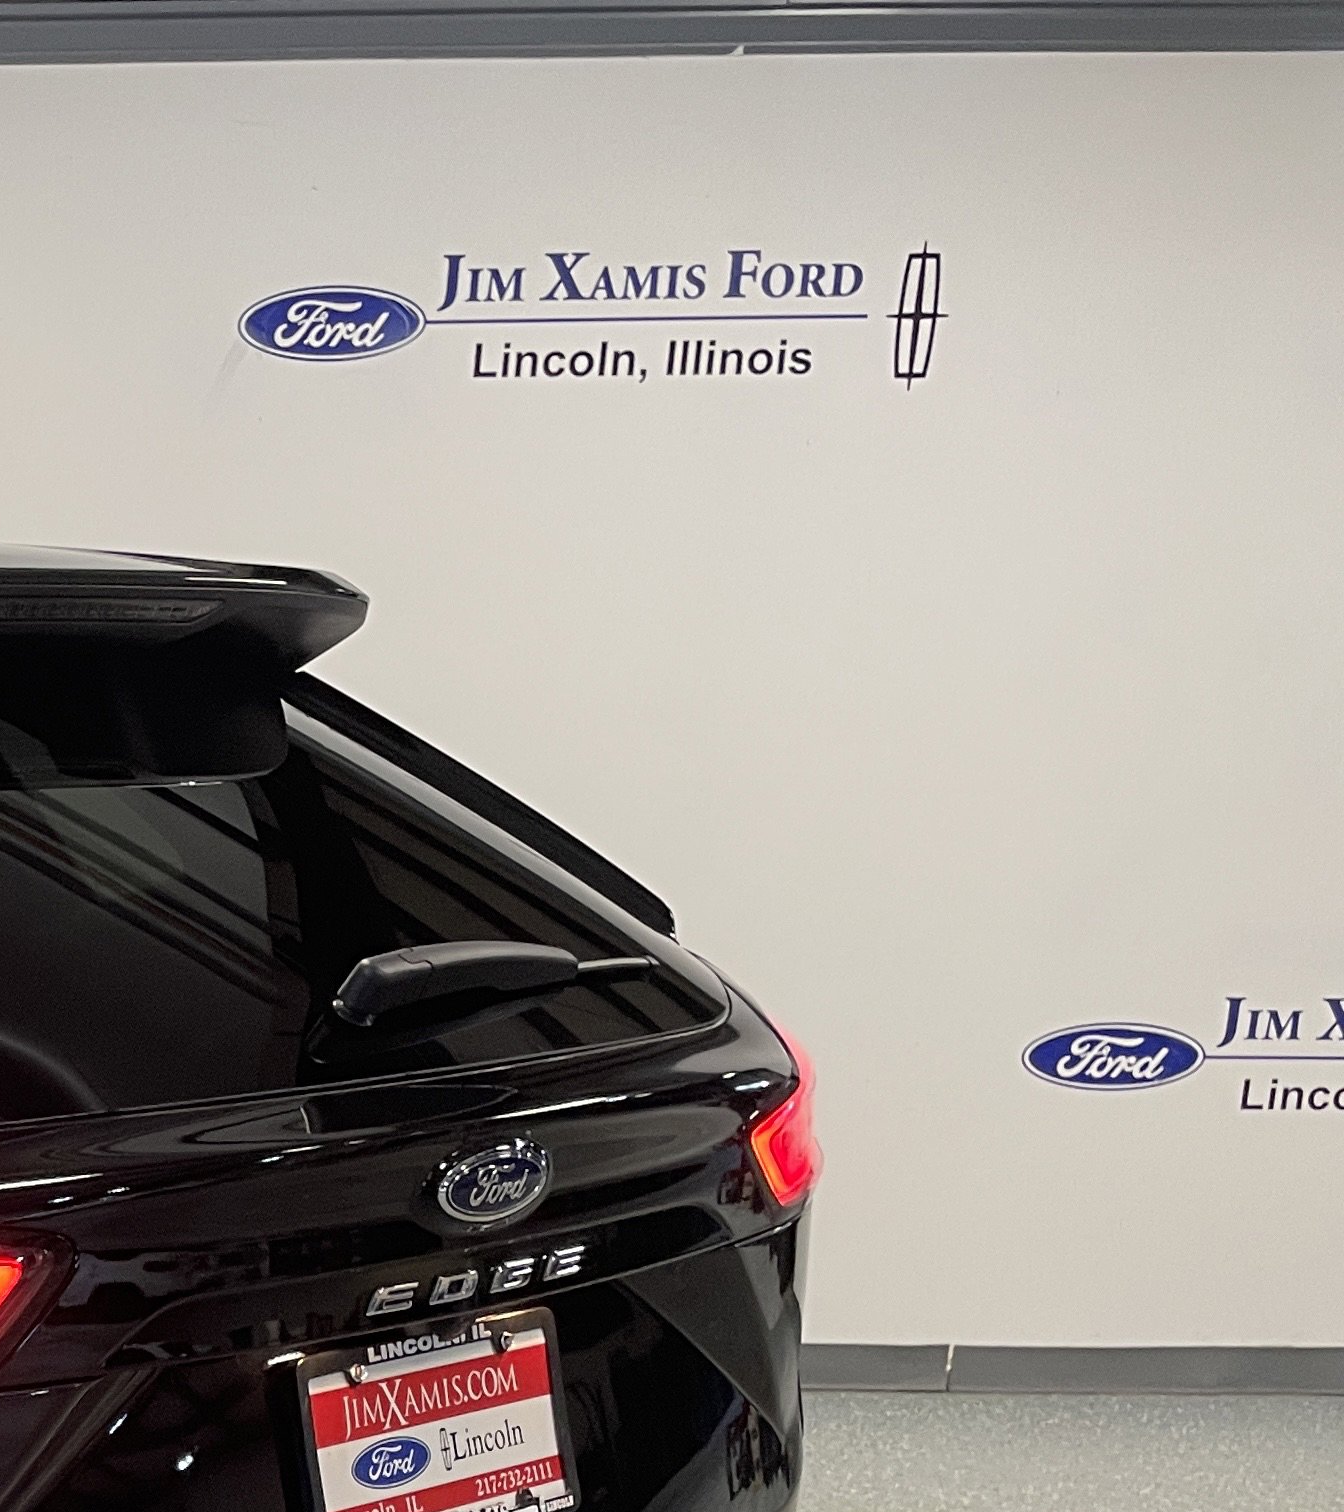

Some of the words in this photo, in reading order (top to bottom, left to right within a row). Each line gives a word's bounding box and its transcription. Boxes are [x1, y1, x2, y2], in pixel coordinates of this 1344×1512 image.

[436, 254, 526, 312] JIM
[539, 252, 706, 302] XAMIS
[722, 249, 864, 298] FORD
[275, 299, 387, 350] Ford
[473, 341, 648, 383] Lincoln,
[665, 339, 813, 376] Illinois
[1216, 996, 1304, 1049] JIM
[1056, 1034, 1169, 1080] Ford
[469, 1163, 530, 1207] Ford
[366, 1245, 586, 1317] EDGE
[472, 1323, 493, 1341] IL
[368, 1444, 416, 1481] Ford
[449, 1418, 526, 1462] Lincoln
[475, 1461, 554, 1497] 217-732-2111
